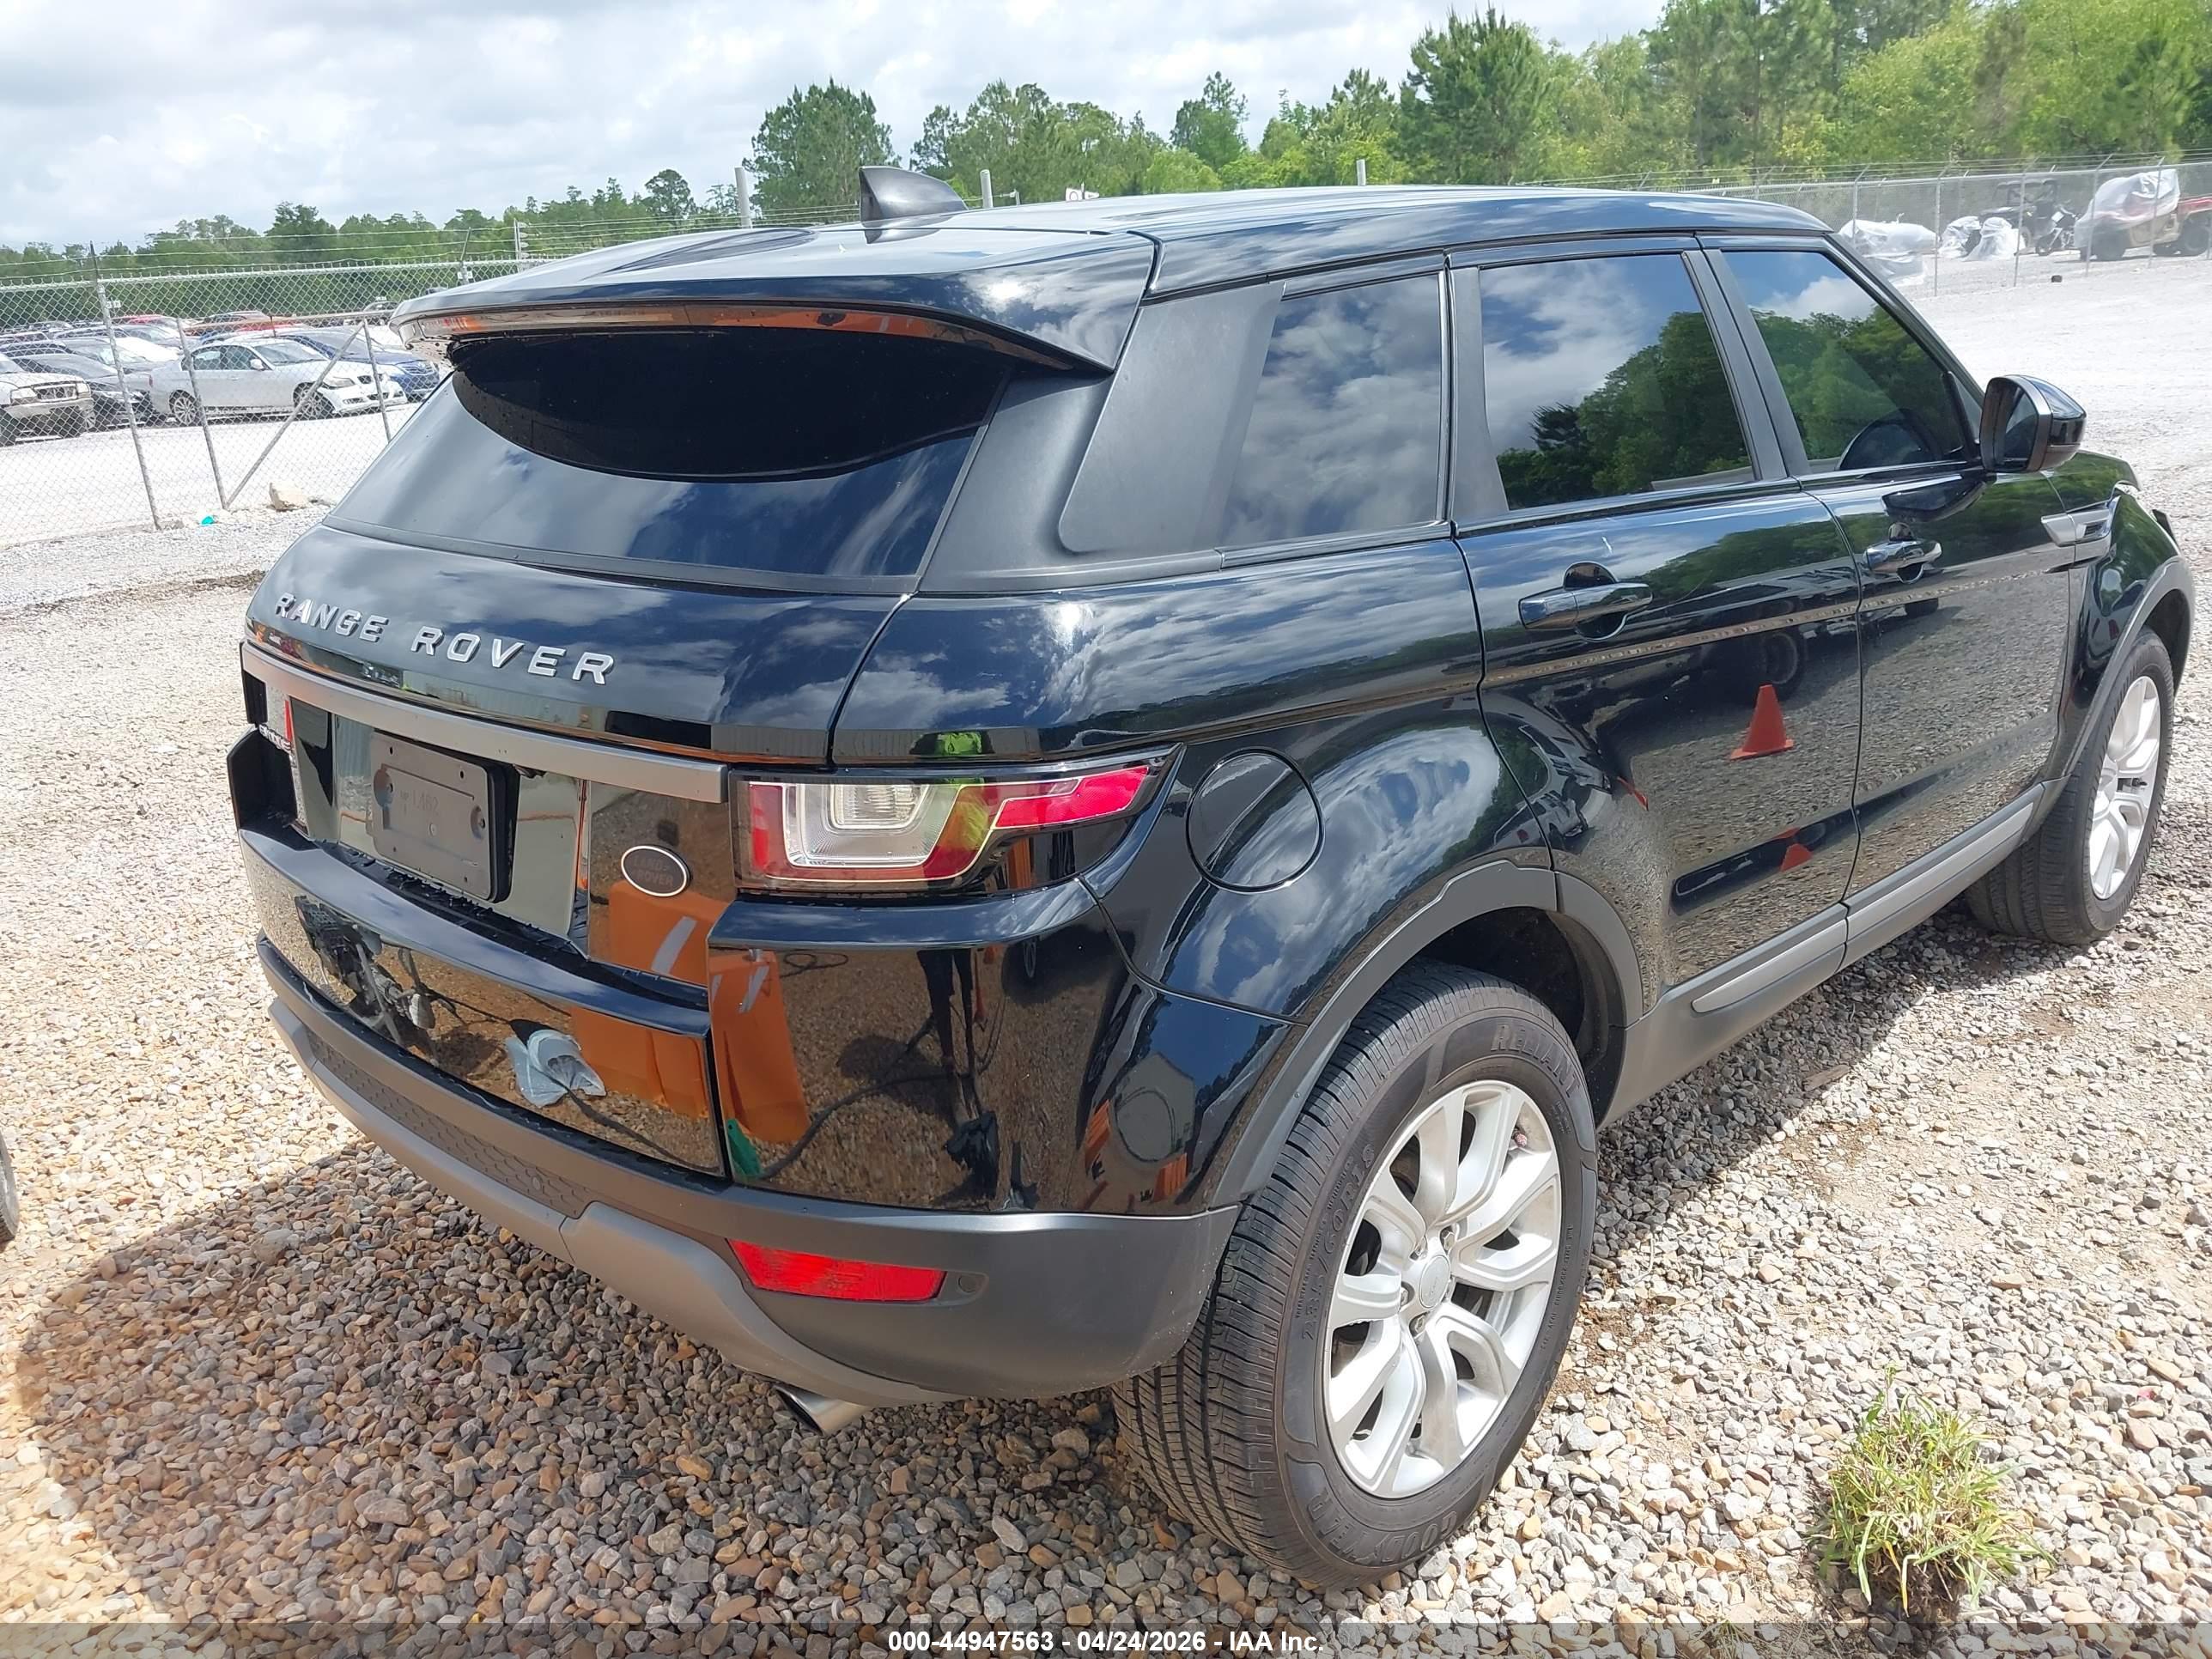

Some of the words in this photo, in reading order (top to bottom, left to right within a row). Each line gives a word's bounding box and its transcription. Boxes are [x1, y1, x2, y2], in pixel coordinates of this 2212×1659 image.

[275, 592, 389, 642] RANGE
[410, 625, 615, 685] ROVER
[1491, 1020, 1581, 1098] RELIANT
[1307, 1487, 1457, 1566] GOODYEAR
